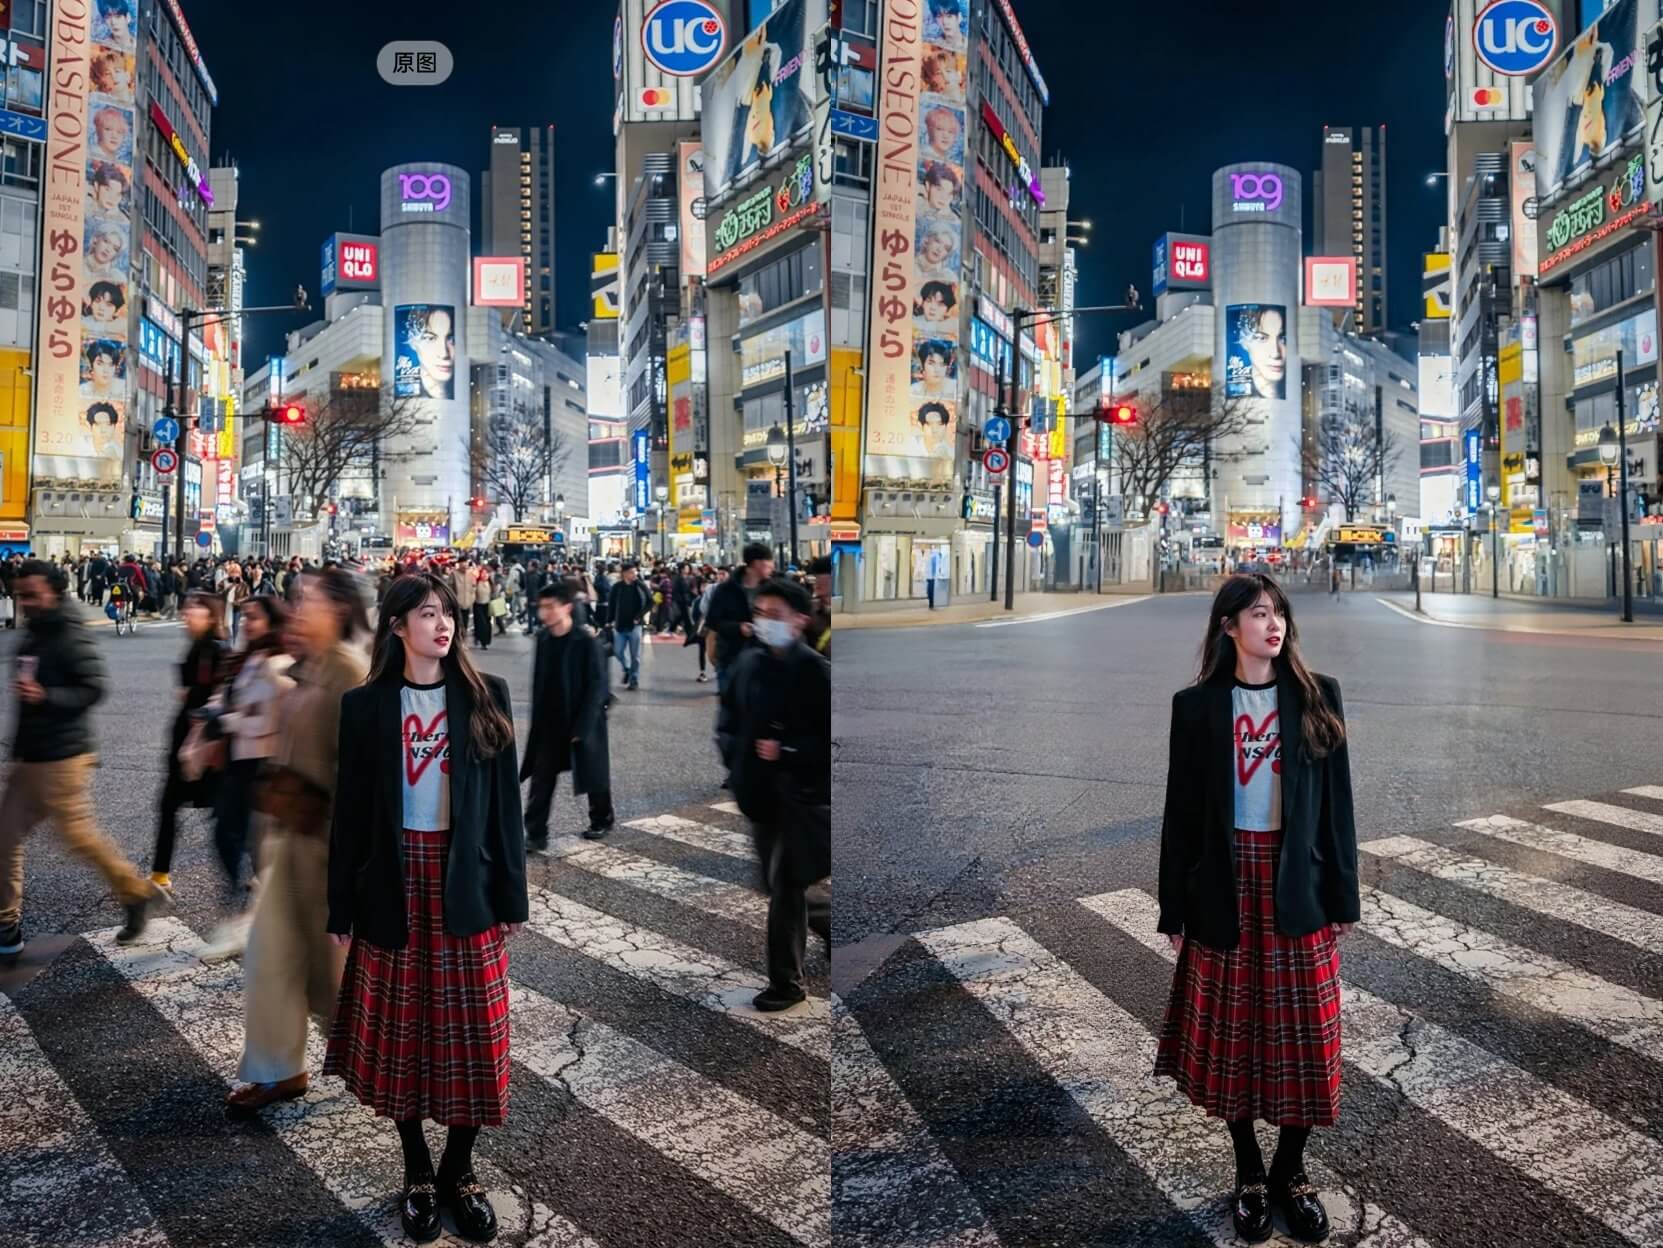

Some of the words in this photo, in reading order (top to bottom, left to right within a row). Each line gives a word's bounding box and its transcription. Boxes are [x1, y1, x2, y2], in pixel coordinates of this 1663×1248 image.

[400, 174, 451, 212] 109
[1231, 174, 1282, 210] 109
[344, 246, 371, 261] UNI
[1175, 246, 1202, 261] UNI
[344, 262, 372, 277] QLO
[47, 229, 78, 359] ゆらゆら
[879, 228, 909, 359] ゆらゆら
[40, 431, 73, 444] 3.20
[872, 431, 904, 444] 3.20
